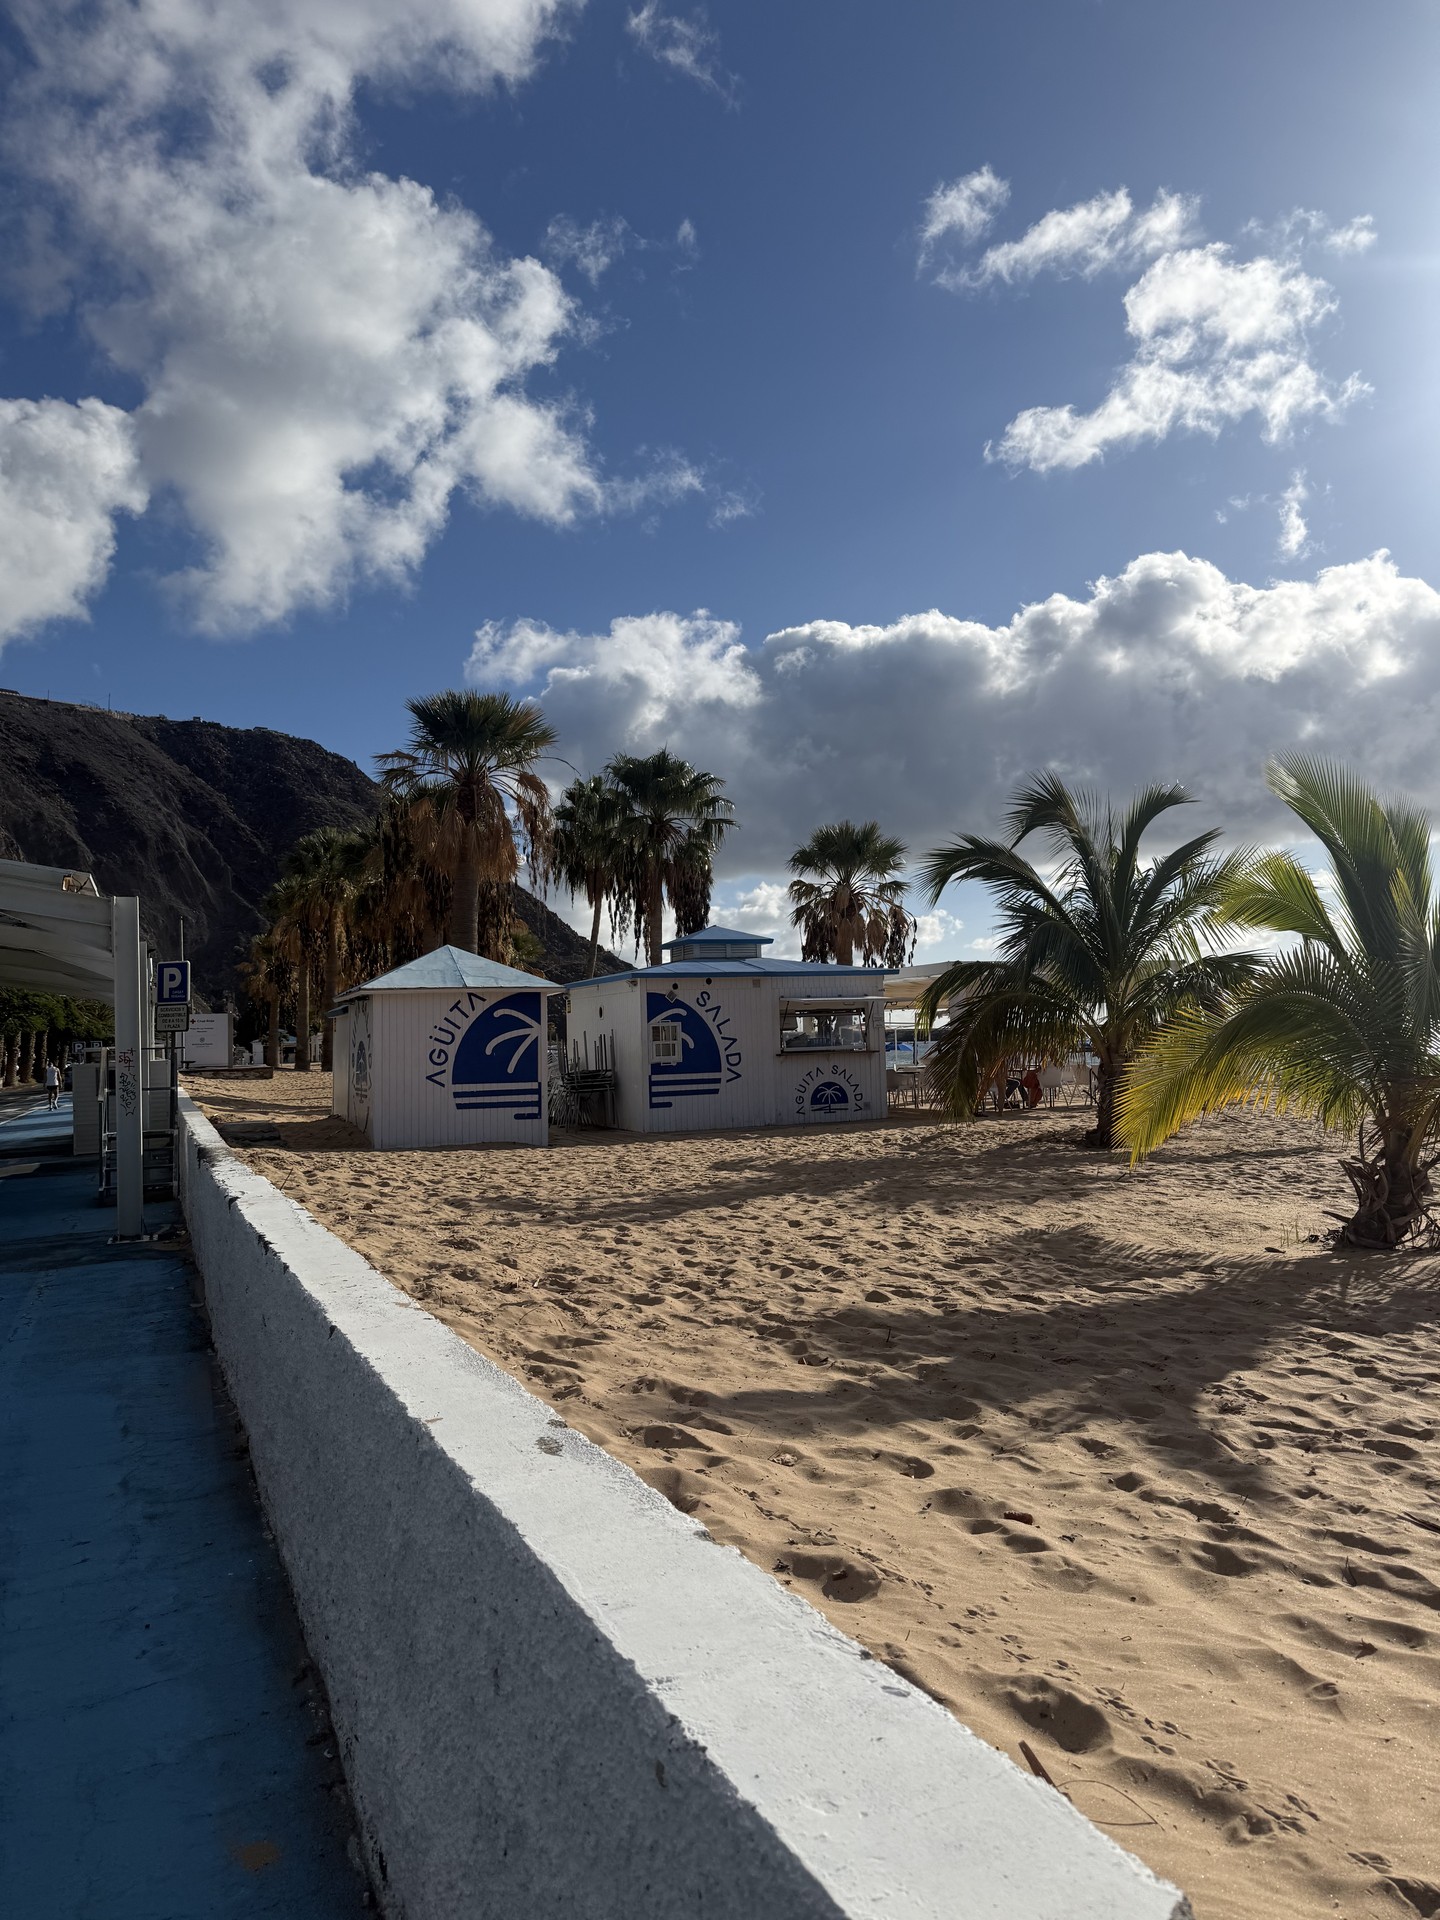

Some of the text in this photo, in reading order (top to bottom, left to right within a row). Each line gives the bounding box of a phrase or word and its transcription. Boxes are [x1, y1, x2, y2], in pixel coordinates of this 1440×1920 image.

[162, 967, 183, 999] P
[74, 1043, 83, 1053] P
[425, 992, 487, 1088] AGÜITA
[696, 990, 742, 1083] SALADA
[831, 1064, 864, 1113] SALADA
